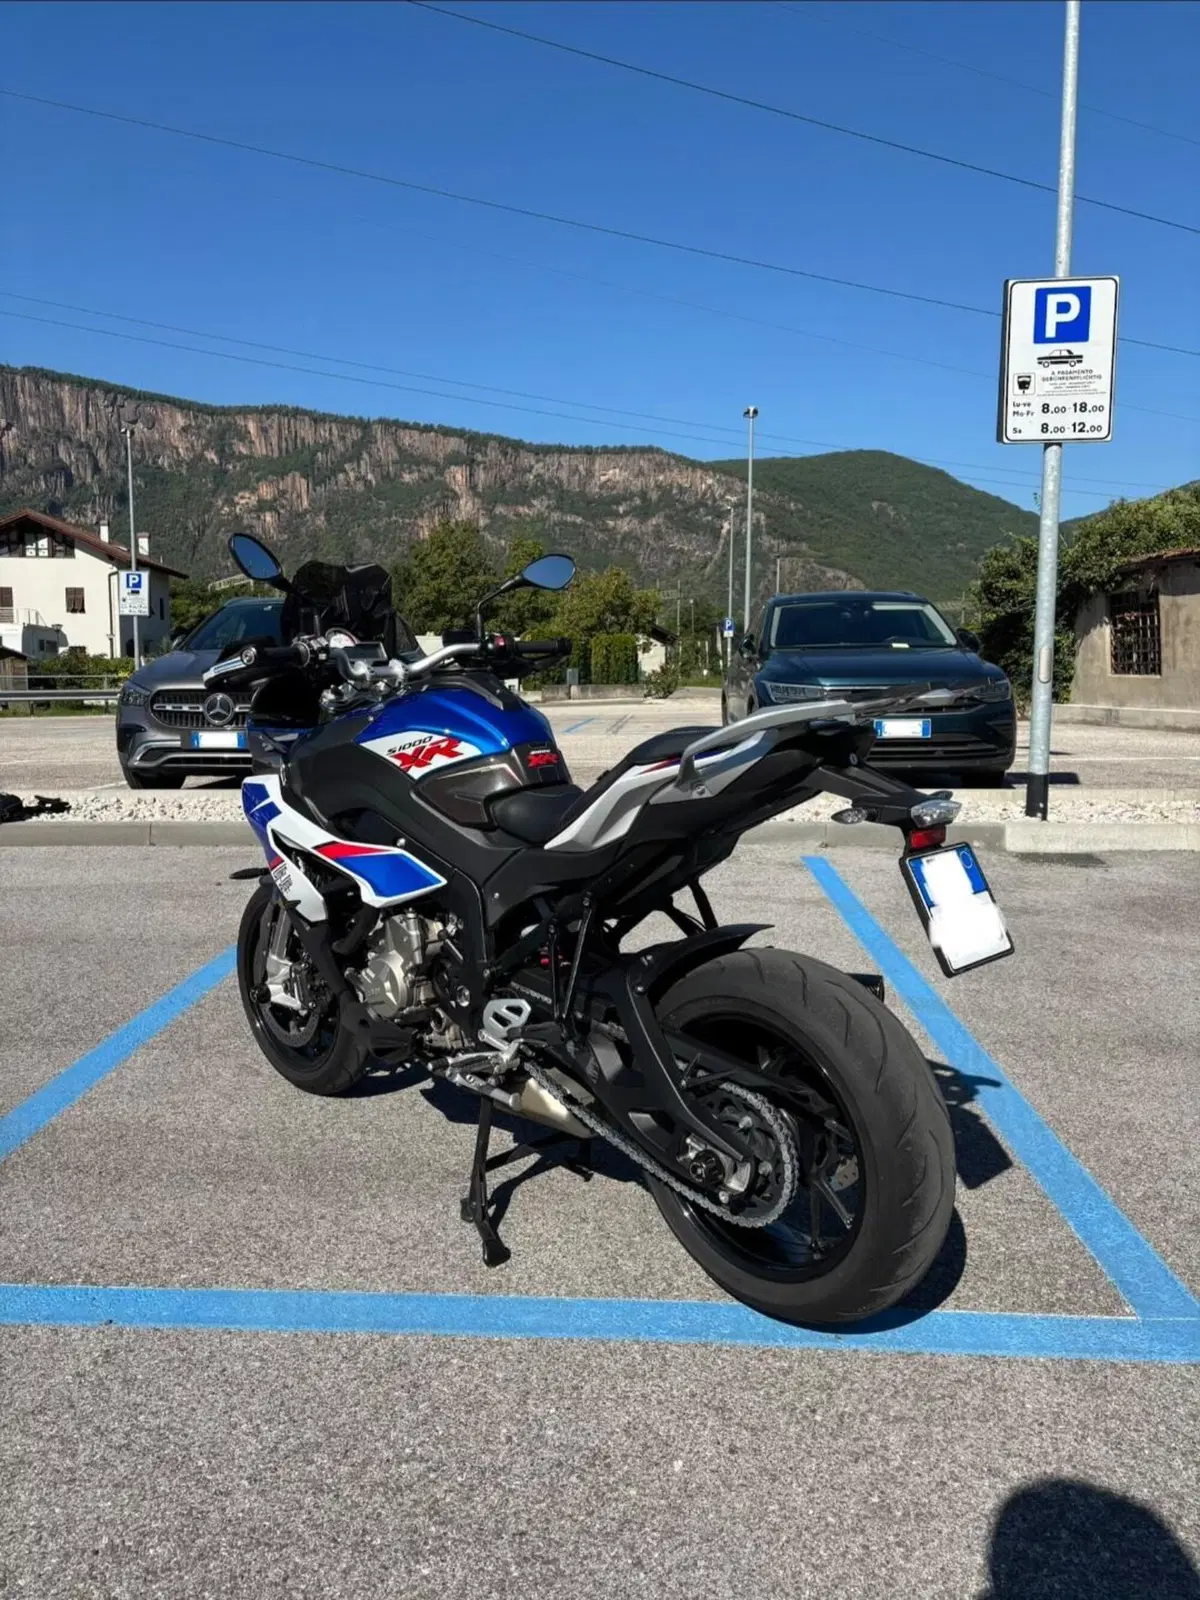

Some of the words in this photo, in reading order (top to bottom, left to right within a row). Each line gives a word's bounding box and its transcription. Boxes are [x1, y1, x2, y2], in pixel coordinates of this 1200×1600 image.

[1045, 293, 1081, 338] P
[129, 575, 139, 587] P
[389, 736, 464, 773] XR
